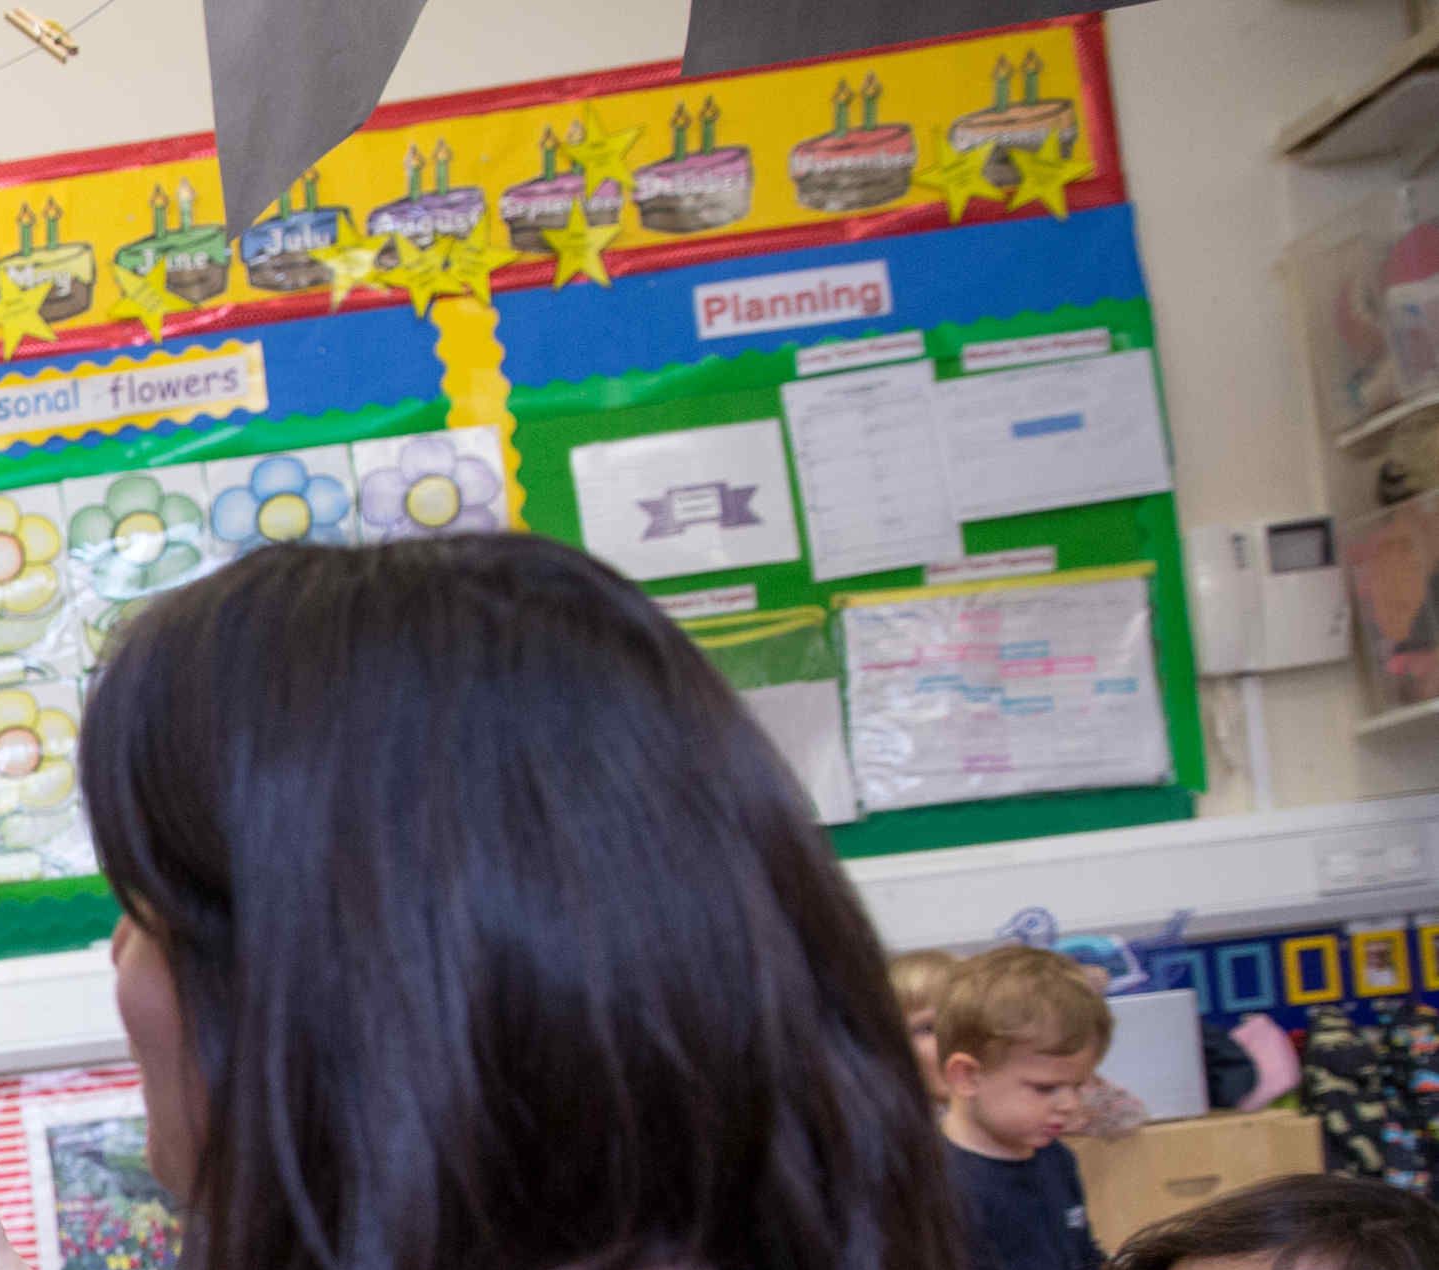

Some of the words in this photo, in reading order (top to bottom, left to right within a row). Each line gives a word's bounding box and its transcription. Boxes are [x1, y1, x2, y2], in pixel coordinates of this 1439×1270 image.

[376, 206, 482, 246] August
[703, 281, 883, 328] Planning
[107, 366, 240, 408] flowers
